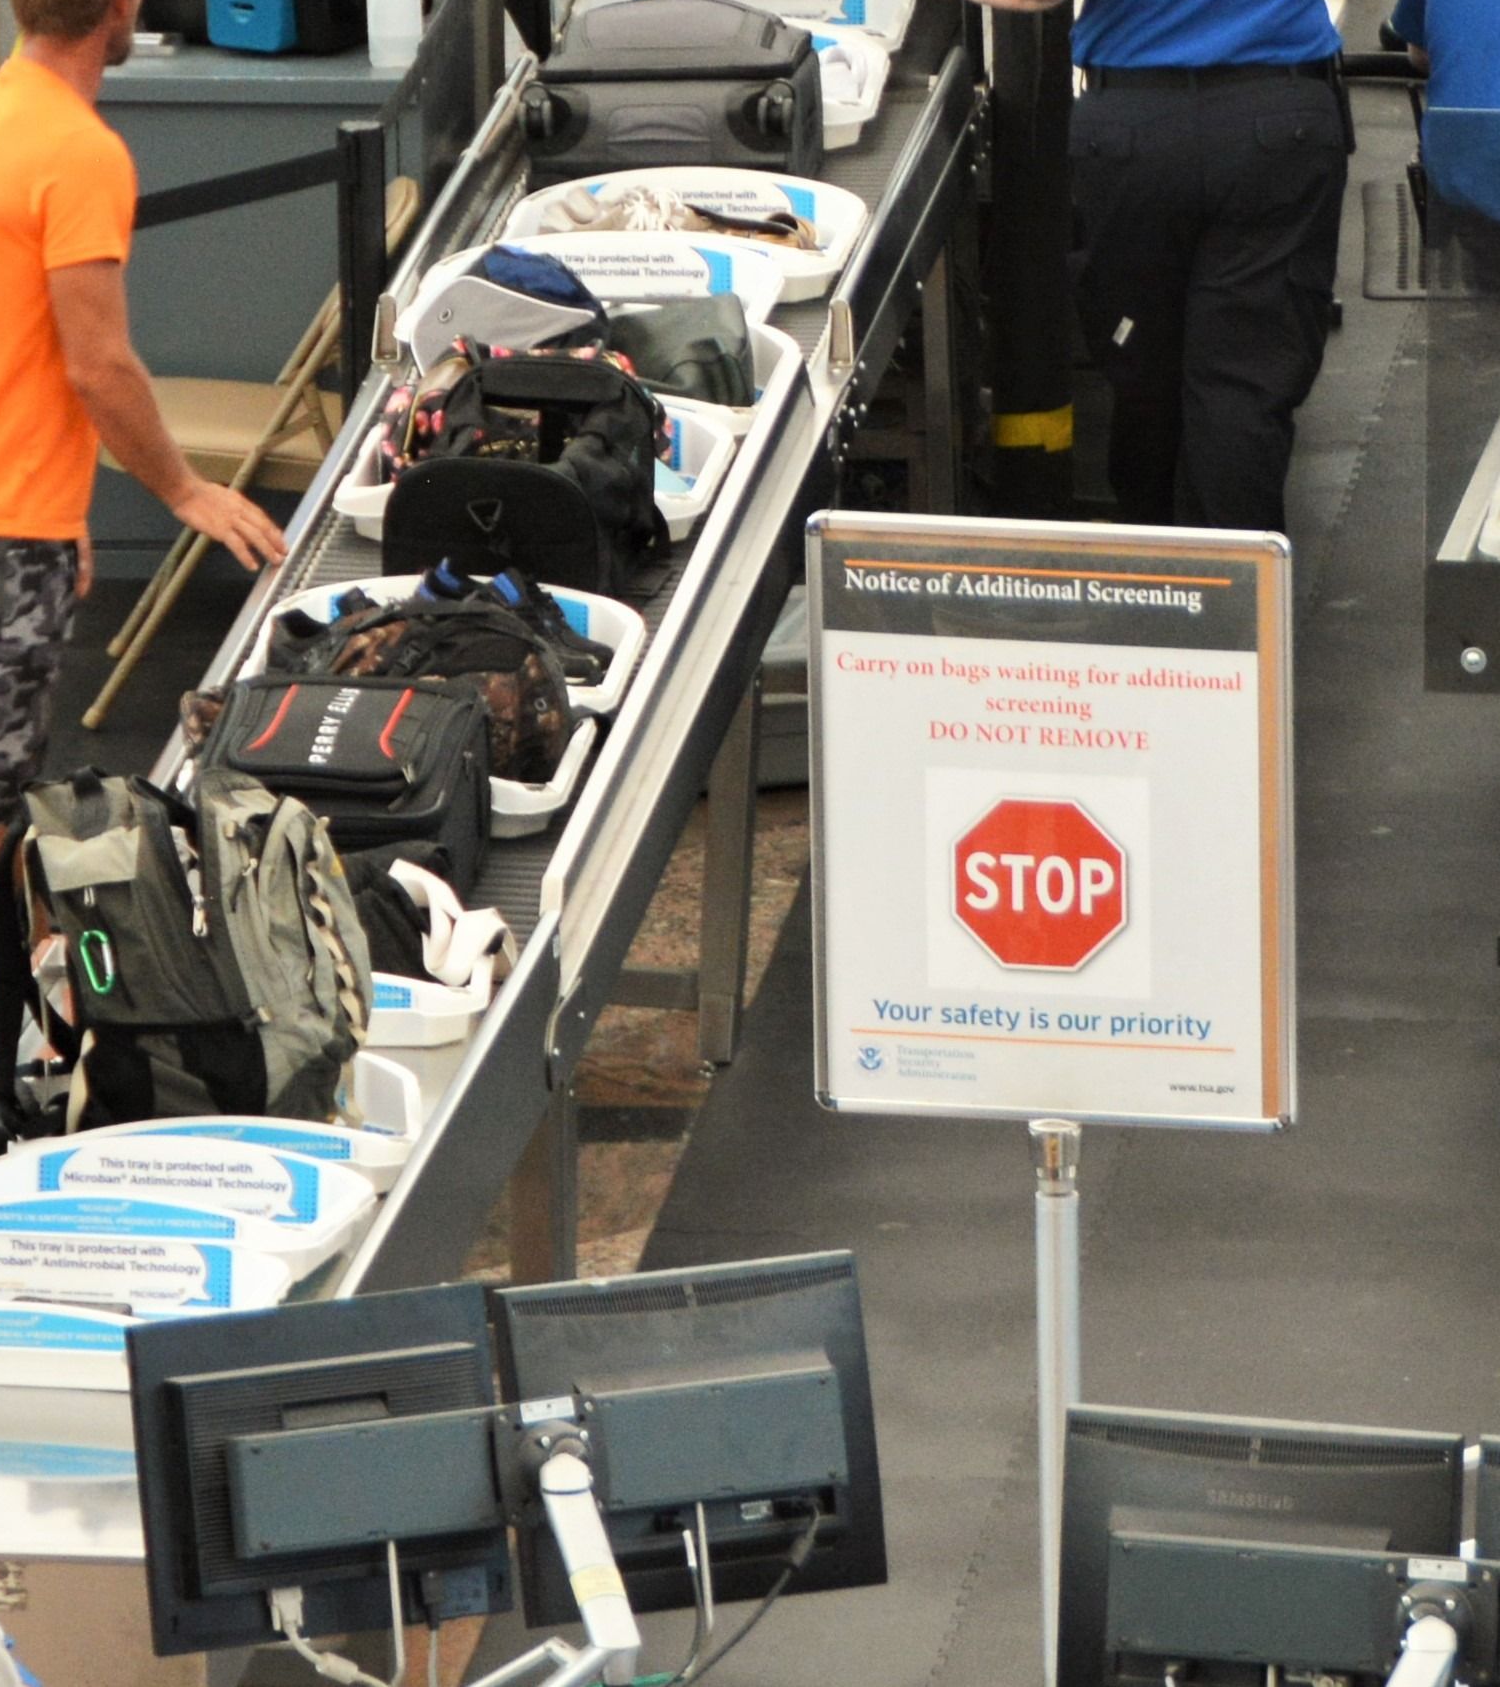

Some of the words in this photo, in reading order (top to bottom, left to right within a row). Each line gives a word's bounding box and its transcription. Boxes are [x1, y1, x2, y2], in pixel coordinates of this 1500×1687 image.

[599, 253, 650, 263] protected
[651, 253, 675, 263] with
[643, 267, 704, 279] Technology
[845, 567, 920, 592] Notice
[927, 572, 953, 593] of
[958, 573, 1081, 602] Additional
[1087, 580, 1202, 612] Screening
[837, 652, 899, 678] Carry
[906, 658, 934, 675] on
[942, 658, 990, 684] bags
[997, 663, 1081, 687] waiting
[1087, 666, 1120, 685] for
[1126, 668, 1243, 692] additional
[986, 695, 1092, 720] screening
[308, 716, 343, 763] PERRY
[930, 720, 969, 740] DO
[975, 723, 1030, 744] NOT
[1040, 726, 1149, 750] REMOVE
[965, 850, 1115, 916] STOP
[873, 999, 933, 1024] Your
[941, 1004, 1020, 1032] safety
[1029, 1007, 1049, 1029] is
[1057, 1012, 1102, 1031] our
[1110, 1013, 1211, 1041] priority
[1169, 1082, 1236, 1096] www.tsa.gov
[100, 1158, 125, 1169] This
[127, 1160, 151, 1173] tray
[153, 1160, 163, 1170] is
[165, 1161, 224, 1175] protected
[226, 1164, 253, 1174] with
[130, 1174, 213, 1189] Antimicrobial
[217, 1177, 288, 1192] Technology
[10, 1239, 36, 1252] This
[38, 1241, 62, 1254] tray
[64, 1241, 75, 1252] is
[77, 1243, 137, 1257] protected
[140, 1245, 166, 1256] with
[43, 1257, 125, 1271] Antimicrobial
[130, 1260, 201, 1275] Technology
[1205, 1488, 1294, 1510] SAMSUNG
